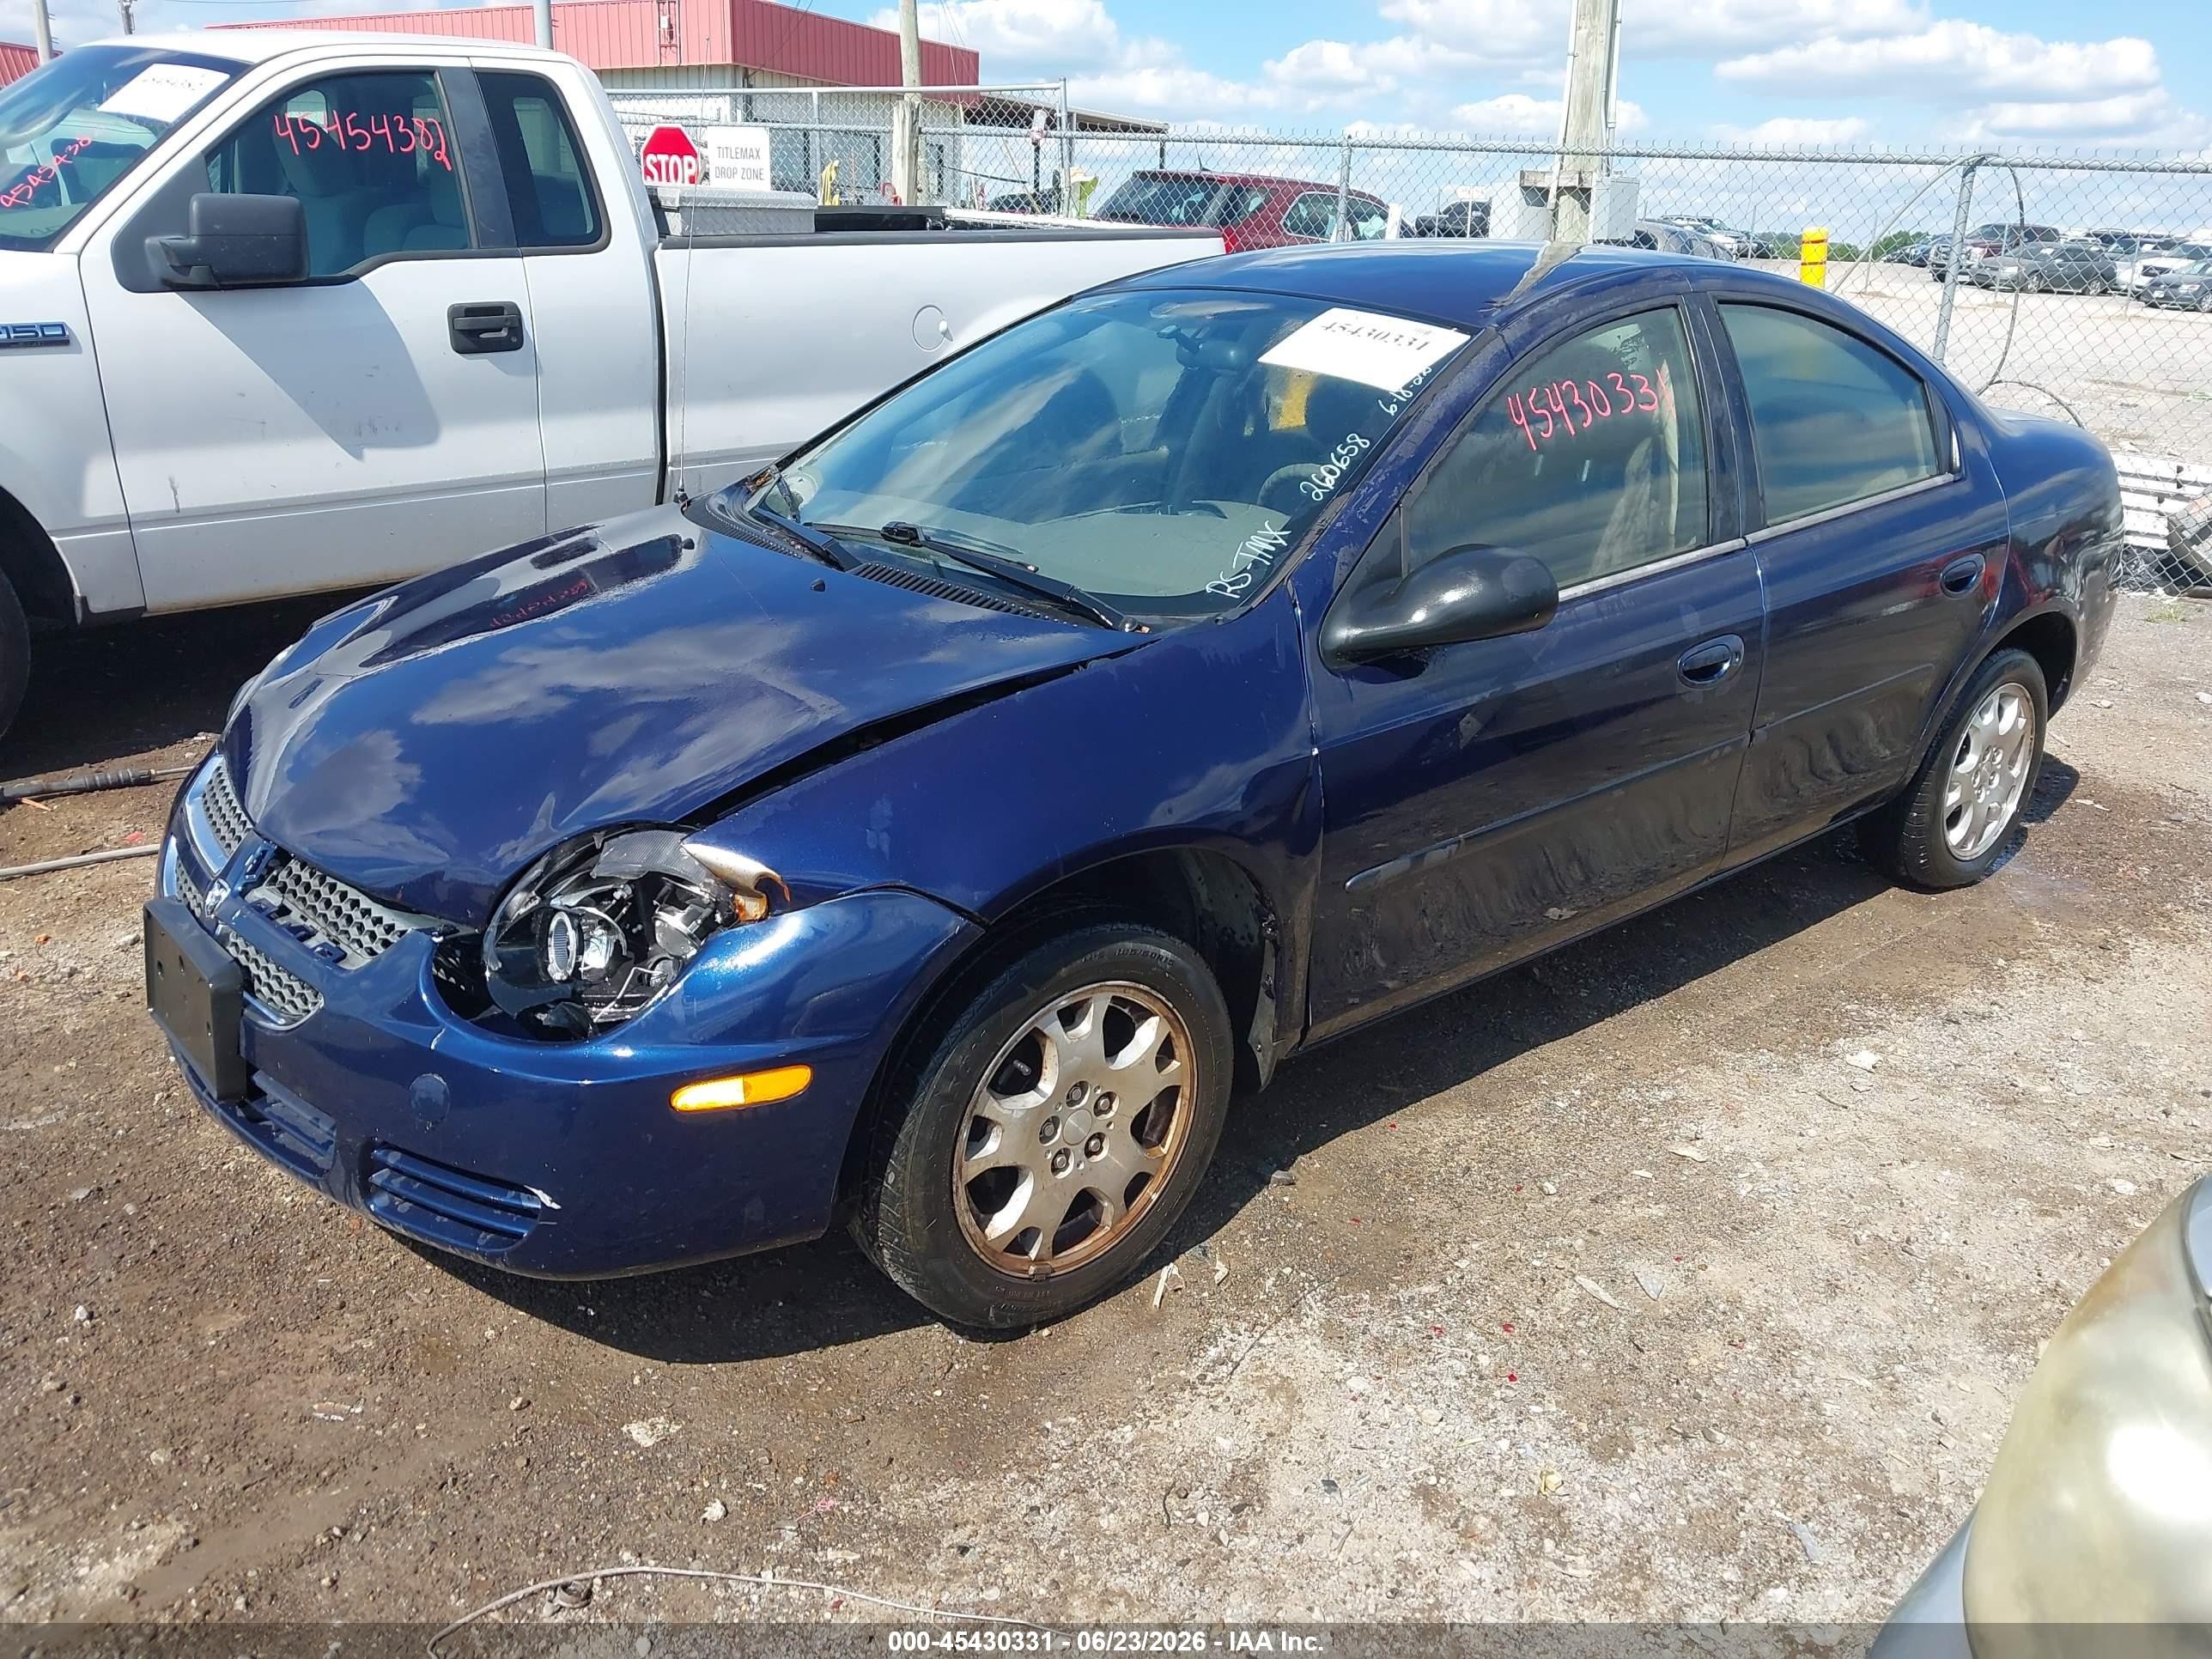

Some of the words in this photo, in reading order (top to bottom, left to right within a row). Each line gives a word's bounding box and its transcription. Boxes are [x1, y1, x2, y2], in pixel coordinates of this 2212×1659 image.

[0, 134, 93, 208] 4545438
[274, 109, 452, 171] 45454382
[646, 153, 697, 185] STOP
[717, 146, 761, 160] TITLEMAX
[714, 166, 738, 179] DROP
[741, 167, 765, 181] ZONE
[1321, 321, 1431, 350] 45430331
[1508, 372, 1676, 451] 45430331
[1299, 433, 1370, 501] 260658
[1206, 520, 1292, 599] RS-TMX
